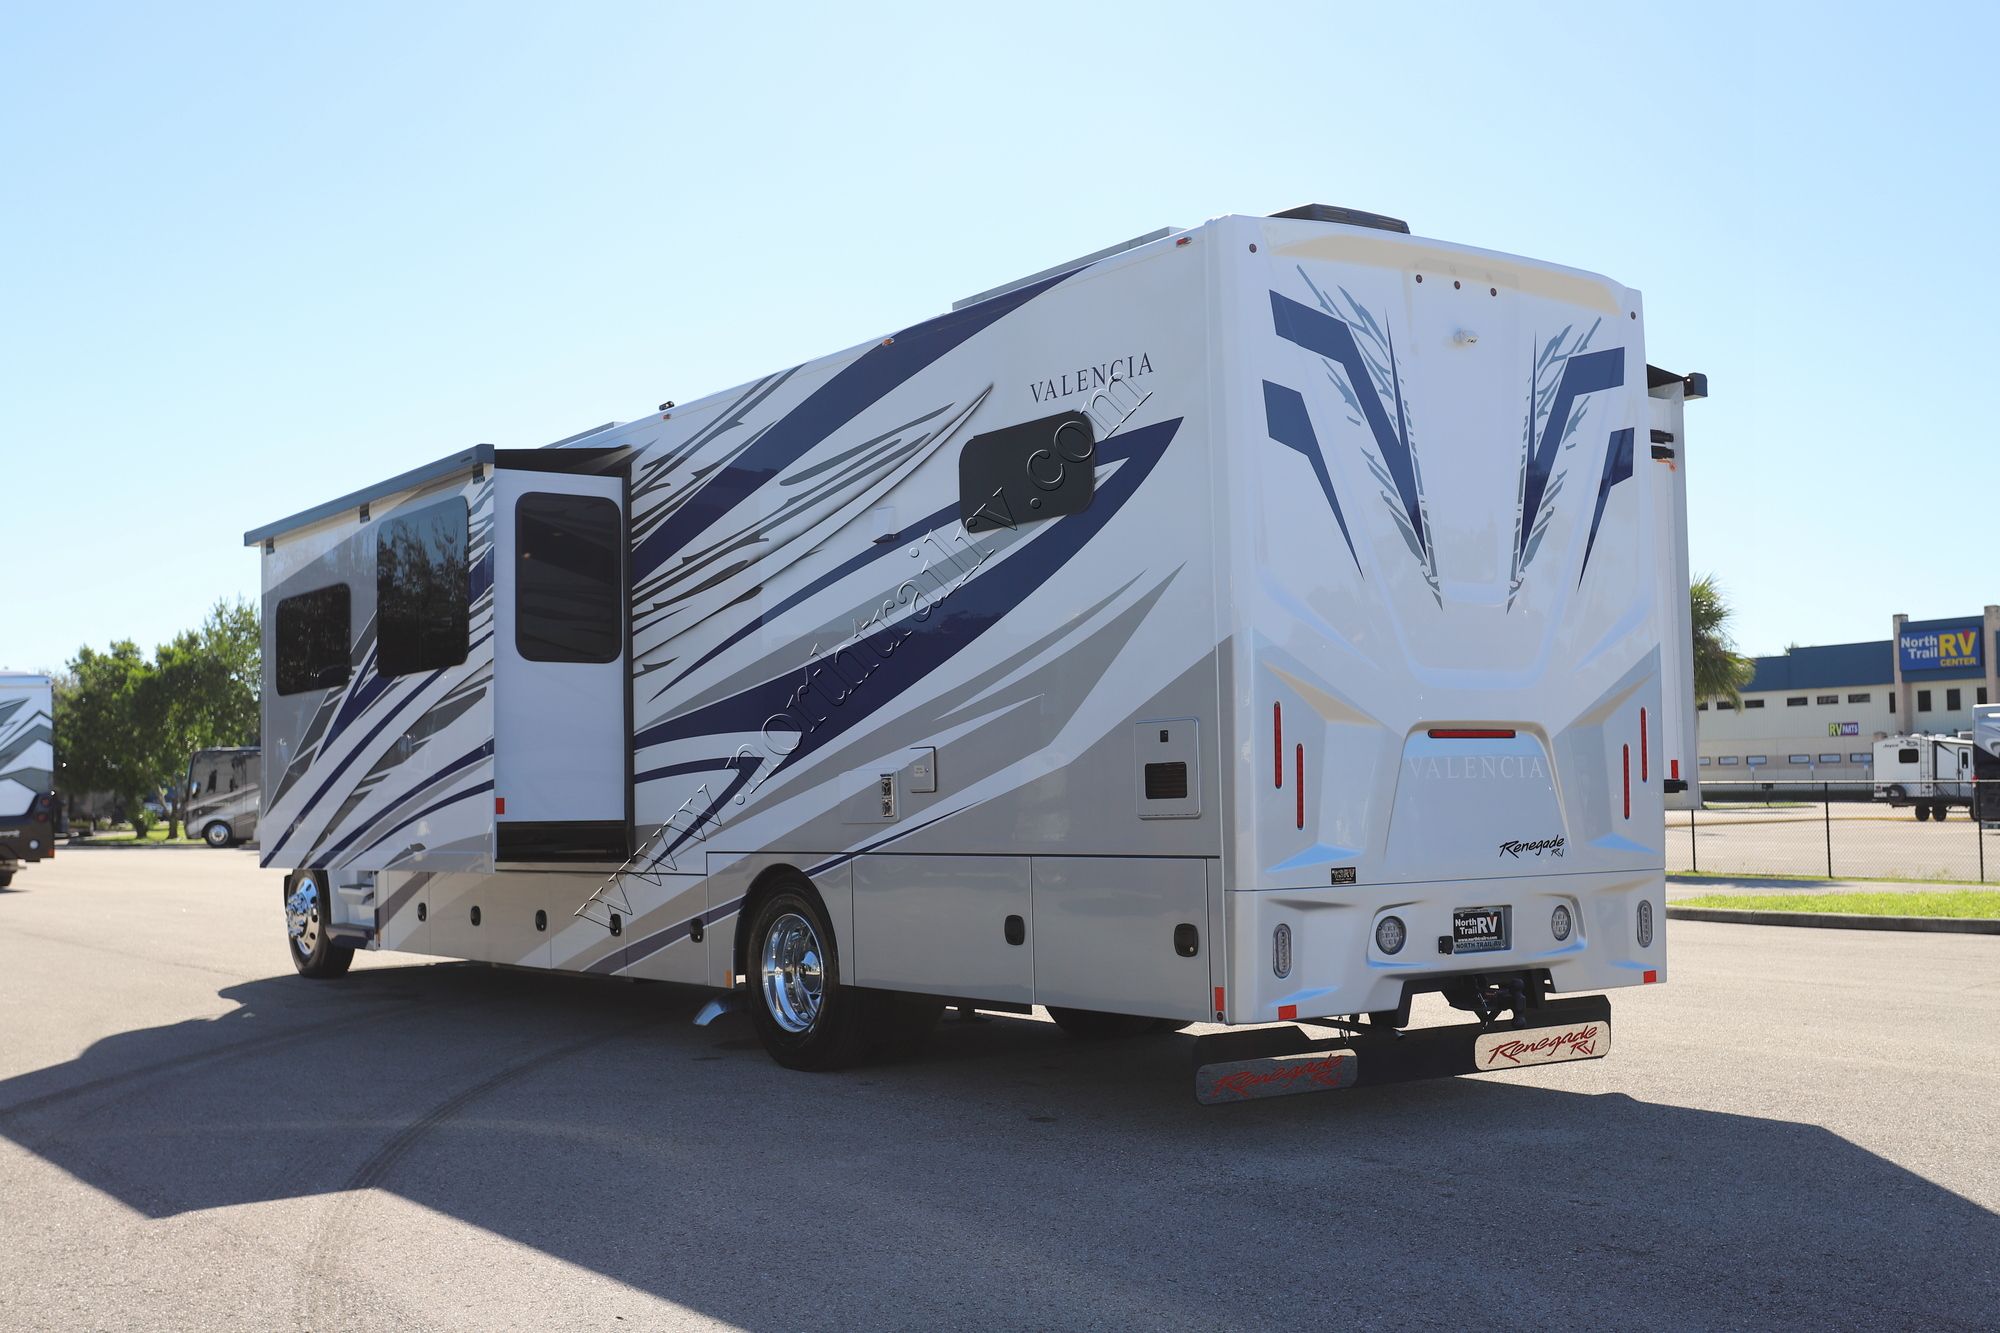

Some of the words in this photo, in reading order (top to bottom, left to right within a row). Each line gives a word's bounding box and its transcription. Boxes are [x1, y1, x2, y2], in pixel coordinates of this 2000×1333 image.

[1030, 352, 1154, 404] VALENCIA
[1901, 635, 1938, 648] North
[1939, 631, 1976, 657] RV
[1908, 646, 1938, 659] Trail
[1940, 657, 1976, 667] CENTER
[1829, 722, 1843, 736] RV
[1842, 723, 1858, 735] PARTS
[1408, 755, 1545, 779] VALENCIA
[1499, 834, 1565, 859] Renegade
[1550, 848, 1565, 857] RV
[1455, 918, 1477, 927] North
[1477, 916, 1498, 934] RV
[1460, 926, 1478, 935] Trail
[1488, 1025, 1598, 1065] Renegade
[1570, 1040, 1596, 1055] RV
[1211, 1053, 1345, 1097] Renegade
